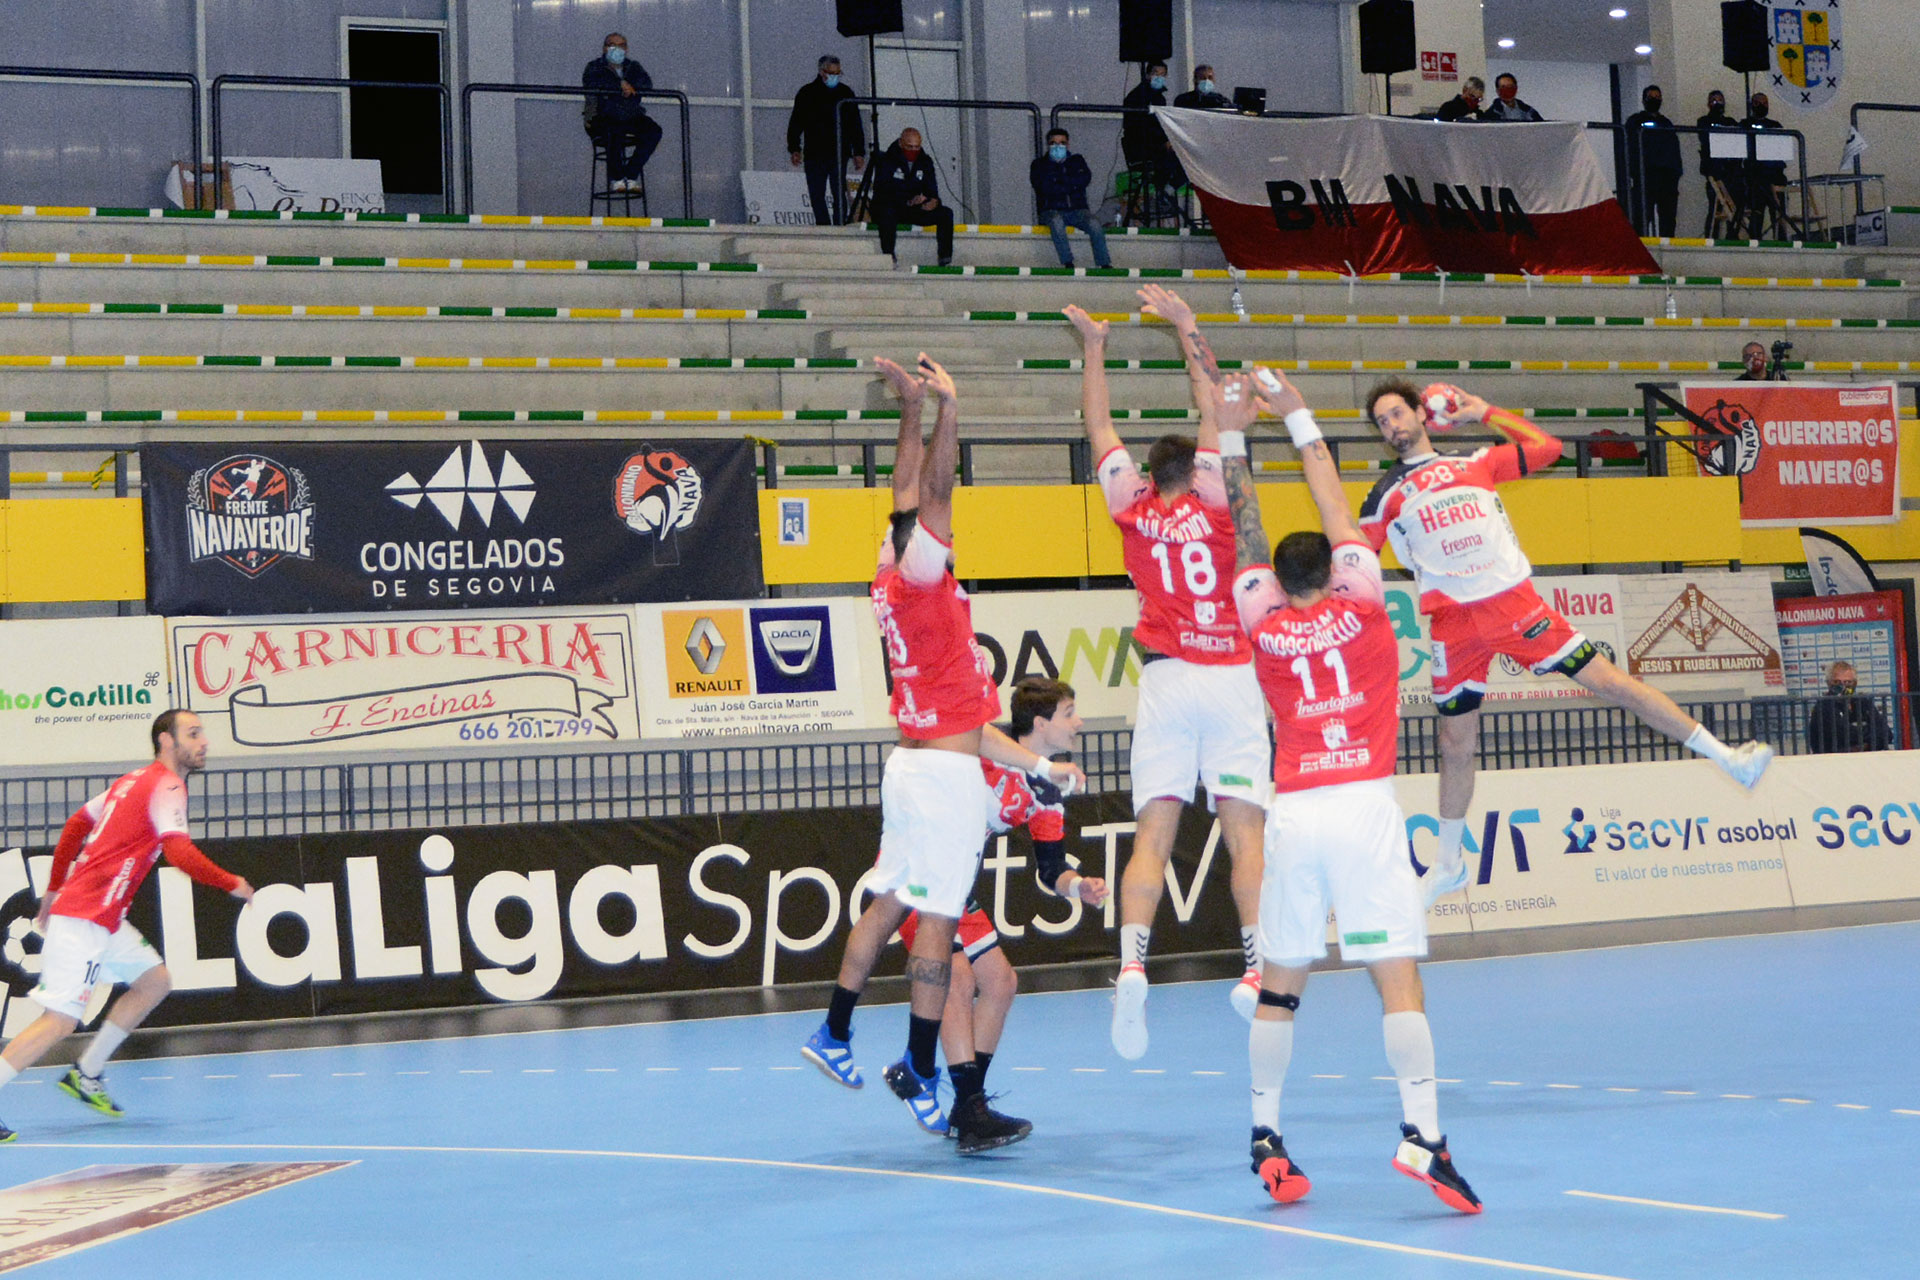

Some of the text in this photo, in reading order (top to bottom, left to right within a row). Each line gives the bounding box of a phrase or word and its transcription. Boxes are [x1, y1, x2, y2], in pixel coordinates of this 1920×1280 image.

[1265, 174, 1538, 240] BM NAVA
[1741, 420, 1756, 459] NAVA
[1763, 418, 1893, 447] GUERRER@S
[1421, 465, 1455, 489] 28
[1778, 458, 1884, 486] NAVER@S
[621, 465, 643, 524] BALONMANO
[674, 466, 698, 512] NAVA
[1432, 492, 1478, 511] VIVEROS
[225, 500, 268, 515] FRENTE
[1418, 501, 1487, 534] HEROL
[190, 508, 314, 559] NAVAVERDE
[1441, 534, 1483, 556] Eresma
[361, 537, 565, 573] CONGELADOS
[1151, 541, 1217, 596] 18
[373, 576, 555, 597] DE SEGOVIA
[1553, 588, 1614, 617] Nava
[1777, 605, 1865, 624] BALONMANO NAVA
[771, 629, 812, 639] DACIA
[1629, 599, 1685, 660] CONSTRUCCIONES
[1702, 597, 1770, 657] REHABILITACIONES
[193, 622, 615, 698] CARNICERIA
[1639, 655, 1765, 673] JESÚS Y RUBÉN MAROTO
[1291, 648, 1350, 700] 11
[676, 680, 743, 694] RENAULT
[1483, 692, 1507, 700] ICIO
[1558, 688, 1594, 697] PERMA
[35, 712, 152, 725] the power of experience
[361, 689, 497, 727] Encinas
[720, 700, 745, 712] José
[741, 714, 759, 722] Nava
[760, 713, 769, 721] de
[821, 709, 854, 719] SEGOVIA
[459, 722, 499, 741] 666
[681, 721, 833, 738] wwwrenaultnavacom
[1600, 806, 1621, 820] Liga
[1604, 816, 1798, 851] sacyr asobal
[1595, 858, 1784, 883] El valor de nuestras manos
[1435, 901, 1498, 917] SERVICIOS
[84, 960, 99, 986] 10
